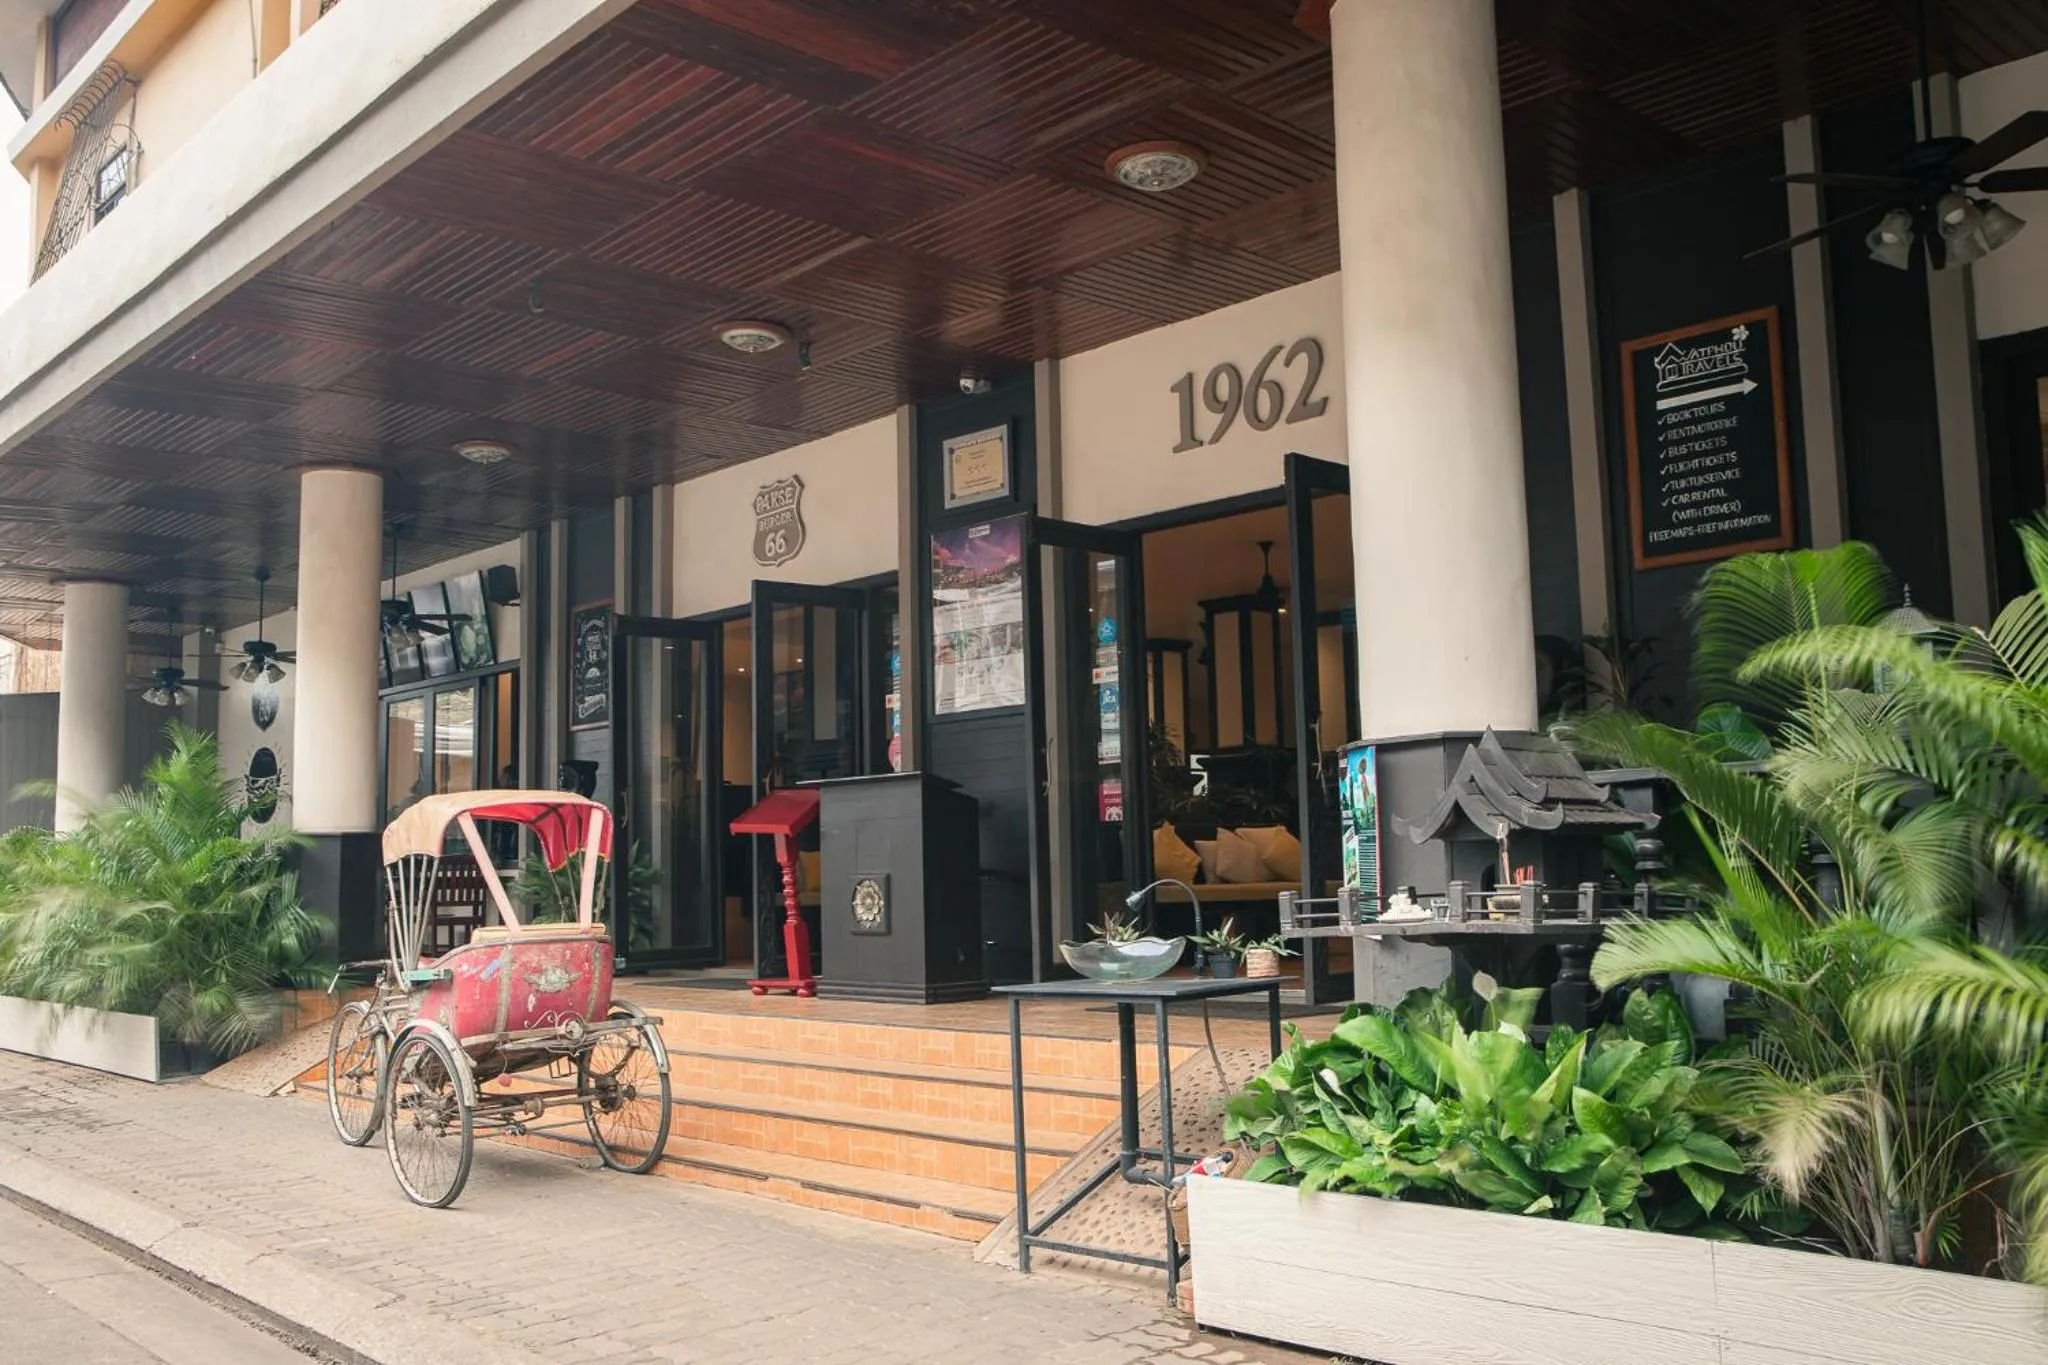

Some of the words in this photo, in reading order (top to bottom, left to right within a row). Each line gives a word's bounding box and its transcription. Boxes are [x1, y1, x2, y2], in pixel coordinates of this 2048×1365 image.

[1681, 352, 1744, 375] TRAVELS
[1170, 337, 1330, 454] 1962
[1666, 409, 1691, 424] BOOK
[1692, 401, 1726, 418] TOURS
[1668, 444, 1688, 458] BUS
[755, 487, 794, 513] PAKSE
[1671, 493, 1691, 505] CAR
[1691, 487, 1728, 502] RENTAL
[758, 511, 792, 531] BURGER
[765, 529, 787, 557] 66
